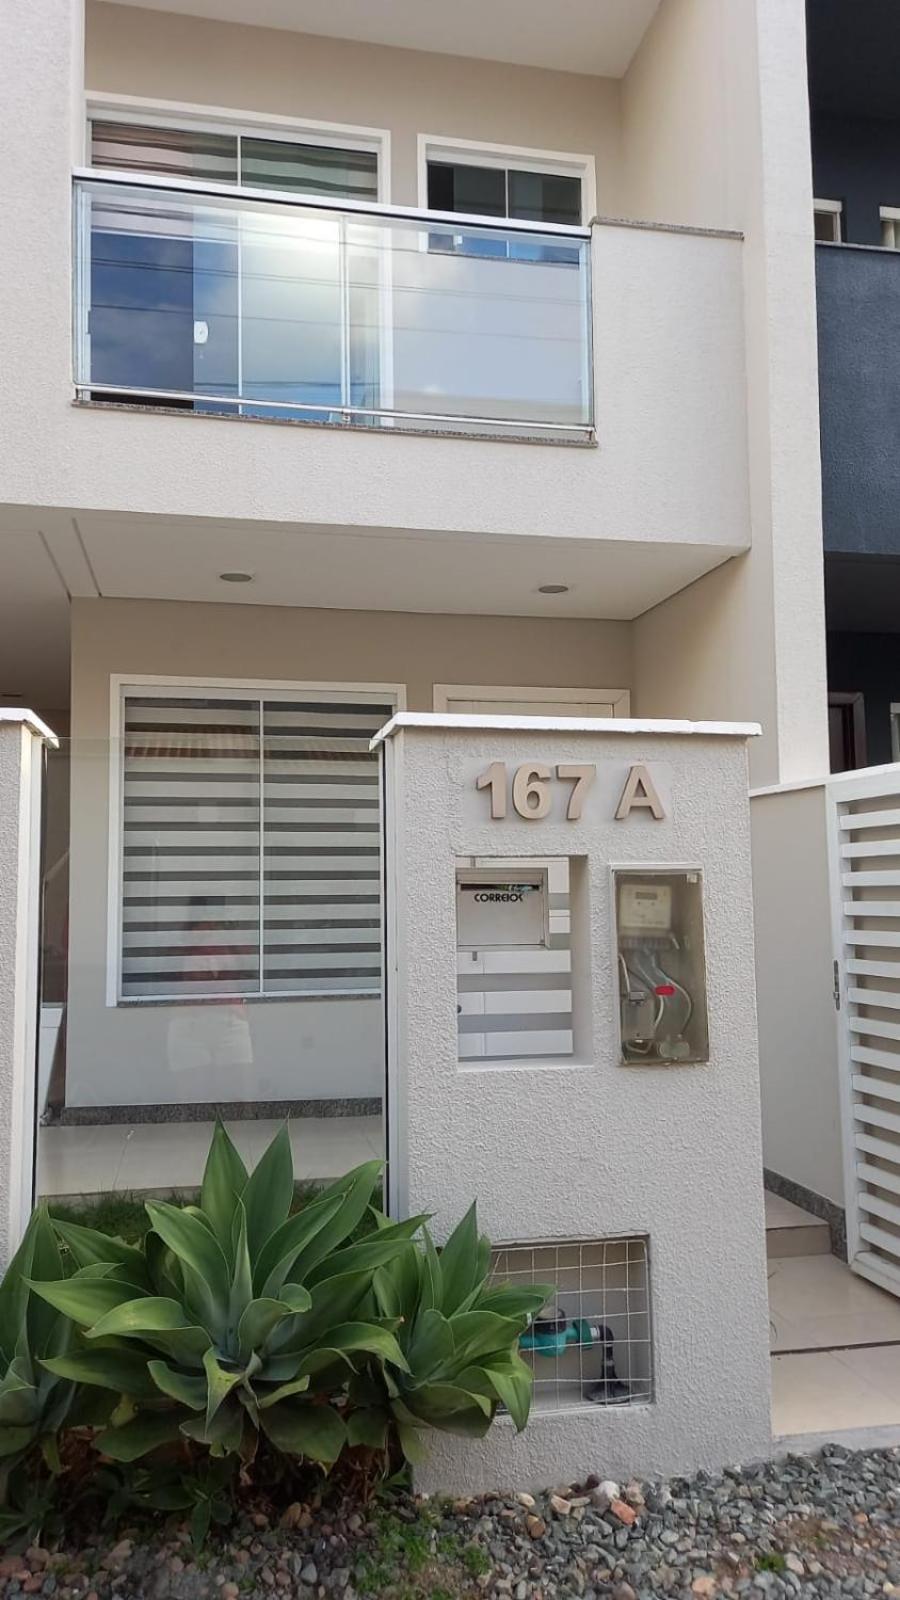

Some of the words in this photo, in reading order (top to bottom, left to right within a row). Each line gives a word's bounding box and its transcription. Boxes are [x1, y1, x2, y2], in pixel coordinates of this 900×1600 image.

[476, 761, 596, 820] 167
[614, 764, 666, 820] A
[474, 893, 523, 903] CORREIOS
